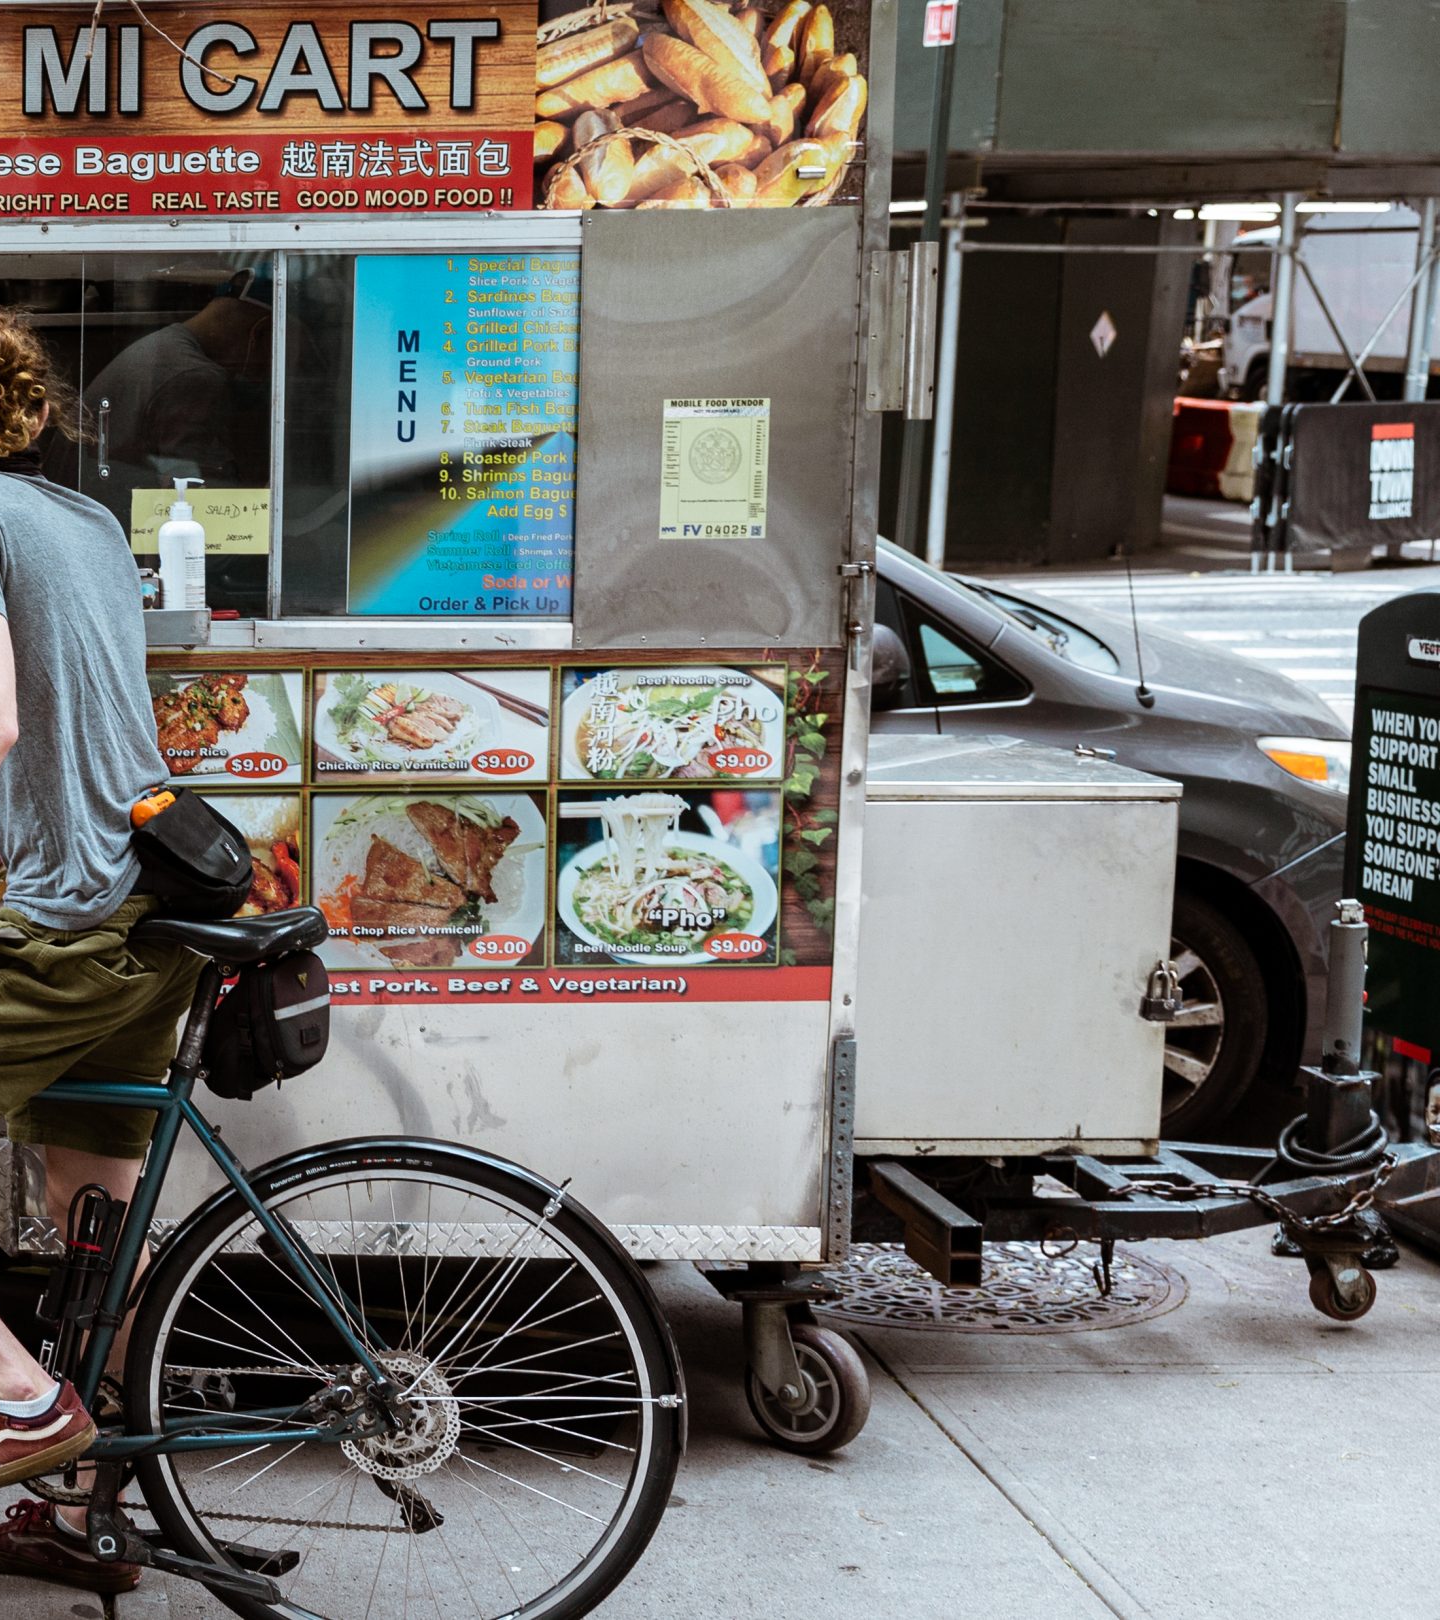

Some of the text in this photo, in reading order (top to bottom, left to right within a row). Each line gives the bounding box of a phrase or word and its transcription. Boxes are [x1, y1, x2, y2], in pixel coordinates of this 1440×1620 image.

[23, 25, 142, 117] MI
[179, 18, 501, 115] CART
[75, 146, 260, 181] Baguette
[281, 139, 511, 179] 越南法式面包
[60, 193, 128, 211] PLACE
[152, 192, 206, 210] REAL
[213, 191, 279, 209] TASTE
[297, 189, 358, 208] GOOD
[365, 189, 427, 207] MOOD
[435, 188, 493, 206] FOOD
[468, 258, 525, 274] Special
[467, 290, 536, 303] Sardines
[466, 321, 518, 334] Grilled
[397, 330, 420, 442] MENU
[465, 371, 547, 387] Vegetarian
[507, 402, 540, 415] Fish
[671, 399, 764, 407] MOBILE FOOD VENDOR
[464, 420, 506, 433] Steak
[463, 451, 567, 464] Roasted Pork
[462, 469, 526, 484] Shrimps
[466, 487, 525, 500] Salmon
[683, 524, 747, 536] FV 04025
[419, 597, 559, 613] Order & Pick Up
[637, 674, 751, 687] Beef Noodle Soup
[714, 695, 778, 723] Pho
[1372, 708, 1415, 738] WHEN
[166, 747, 227, 757] Over Rice
[1369, 735, 1438, 770] SUPPORT
[230, 757, 283, 773] $9.00
[317, 759, 468, 771] Chicken Rice Vermicelli
[476, 754, 530, 769] $9.00
[715, 754, 768, 768] $9.00
[1368, 761, 1417, 793] SMALL
[1367, 787, 1440, 826] BUSINESS
[1366, 814, 1394, 842] YOU
[1363, 866, 1414, 902] DREAM
[328, 924, 483, 937] ork Chop Rice Vermicelli
[475, 941, 527, 955] $9.00
[574, 943, 686, 955] Beef Noodle Soup
[710, 940, 762, 954] $9.00
[369, 979, 439, 994] Pork.
[448, 979, 512, 993] Beef
[519, 978, 540, 993] &
[548, 976, 687, 995] Vegetarian)
[270, 1172, 302, 1190] Panaracer
